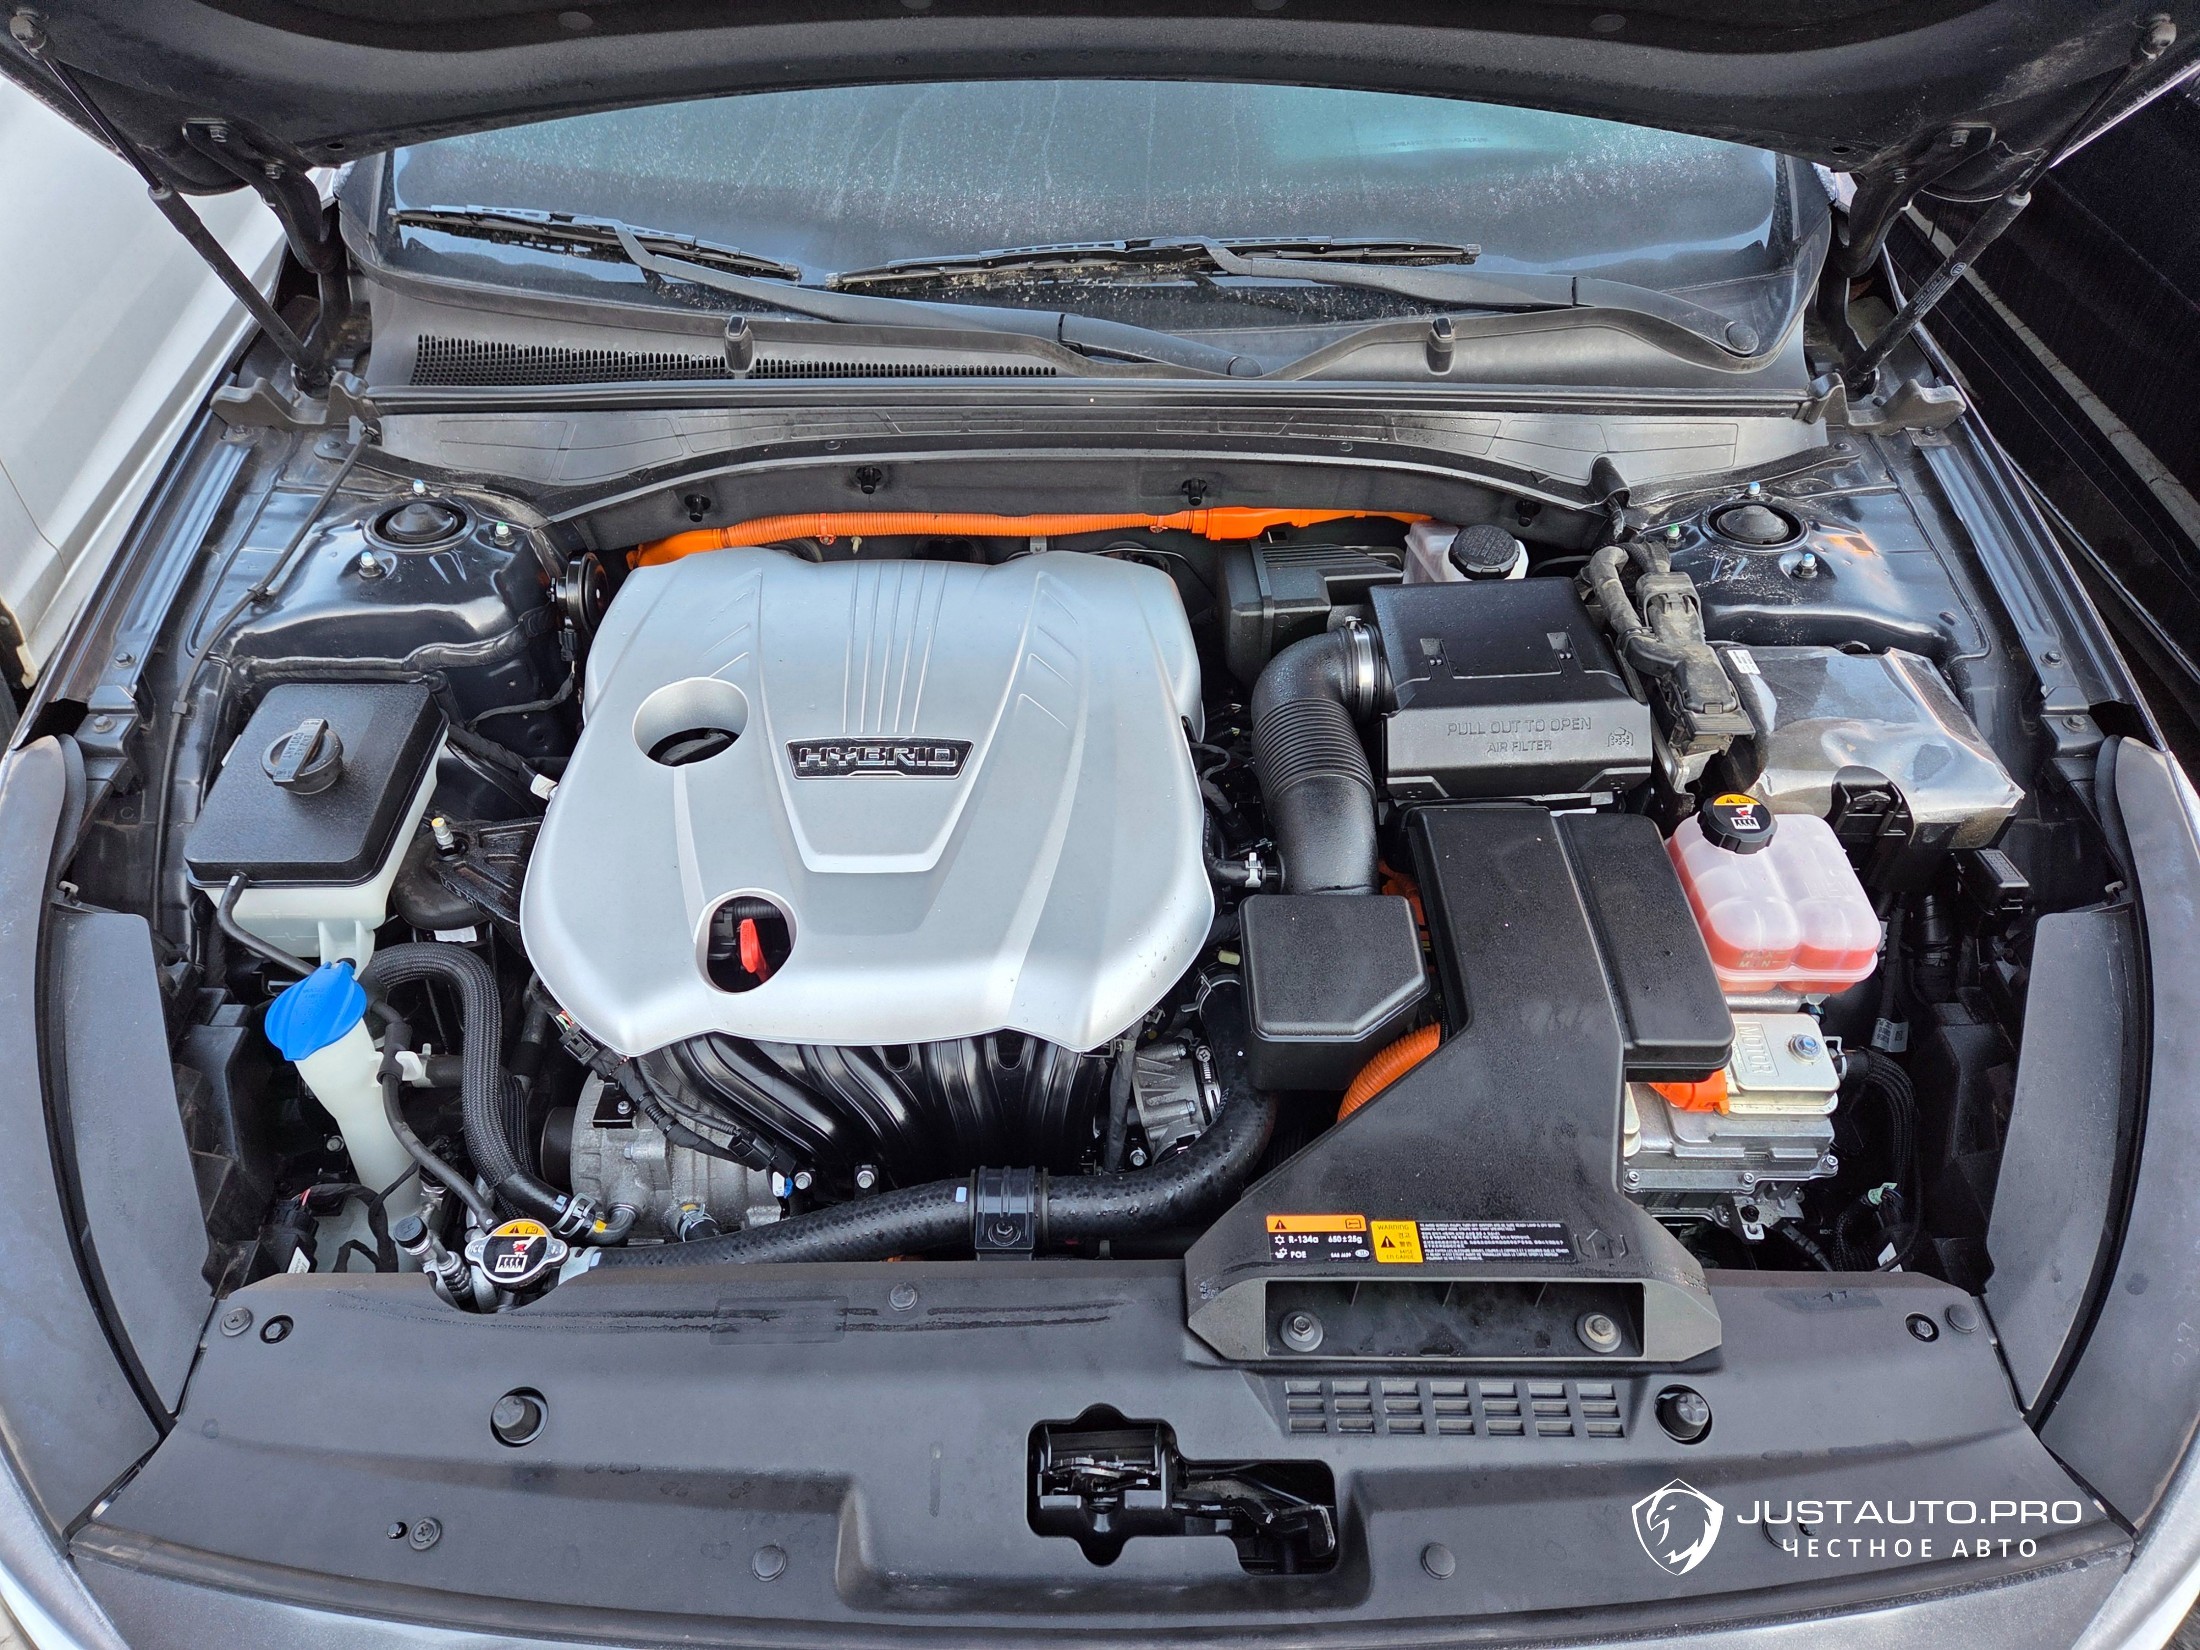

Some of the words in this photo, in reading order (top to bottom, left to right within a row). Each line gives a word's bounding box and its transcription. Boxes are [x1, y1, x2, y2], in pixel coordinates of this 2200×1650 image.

[1447, 722, 1486, 736] PULL
[1490, 720, 1521, 734] OUT
[1524, 719, 1545, 732] TO
[1550, 717, 1592, 732] OPEN
[1487, 742, 1508, 753] AIR
[1511, 740, 1552, 752] FILTER
[799, 747, 958, 767] HYBRID
[1738, 1026, 1773, 1073] MOTOR
[1288, 1235, 1319, 1244] R-134a
[1328, 1235, 1363, 1244] 650±25g
[1290, 1251, 1307, 1259] POE
